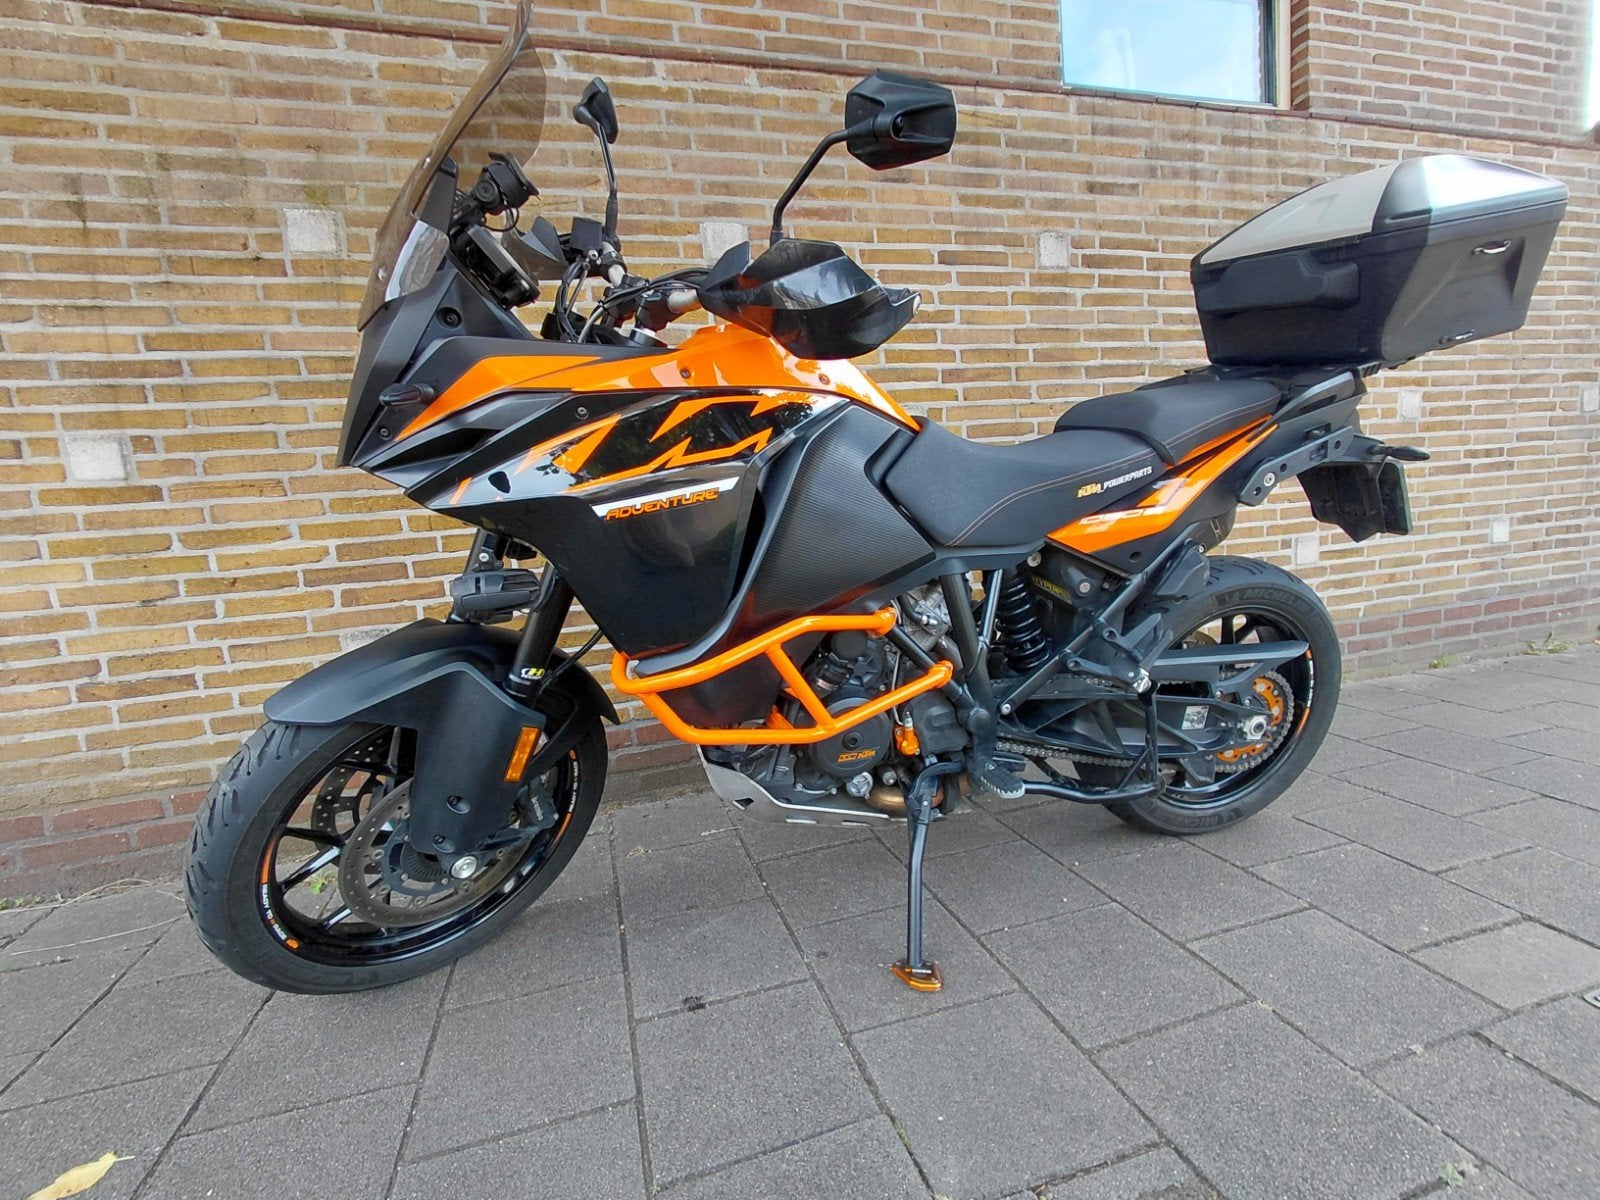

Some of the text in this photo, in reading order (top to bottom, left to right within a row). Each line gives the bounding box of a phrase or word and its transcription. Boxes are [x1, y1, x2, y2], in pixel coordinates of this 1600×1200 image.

[1077, 466, 1152, 498] KTM POWERPARTS
[604, 487, 720, 521] ADVENTURE
